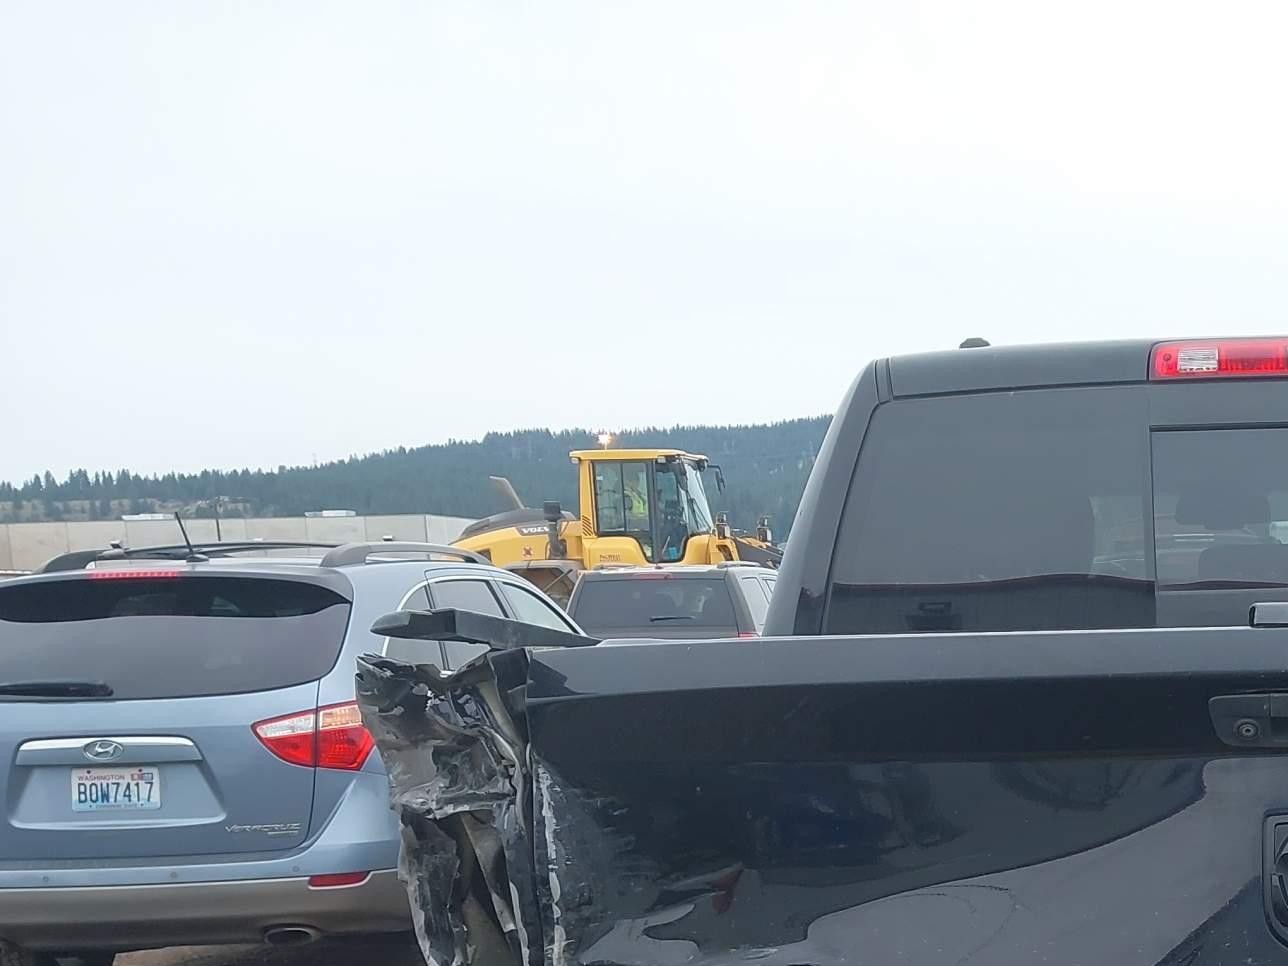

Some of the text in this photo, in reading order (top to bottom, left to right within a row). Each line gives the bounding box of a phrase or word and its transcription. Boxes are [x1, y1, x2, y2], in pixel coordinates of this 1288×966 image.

[521, 526, 550, 534] VOLV
[77, 774, 125, 782] WASHINGTON
[77, 781, 154, 803] BOW7417
